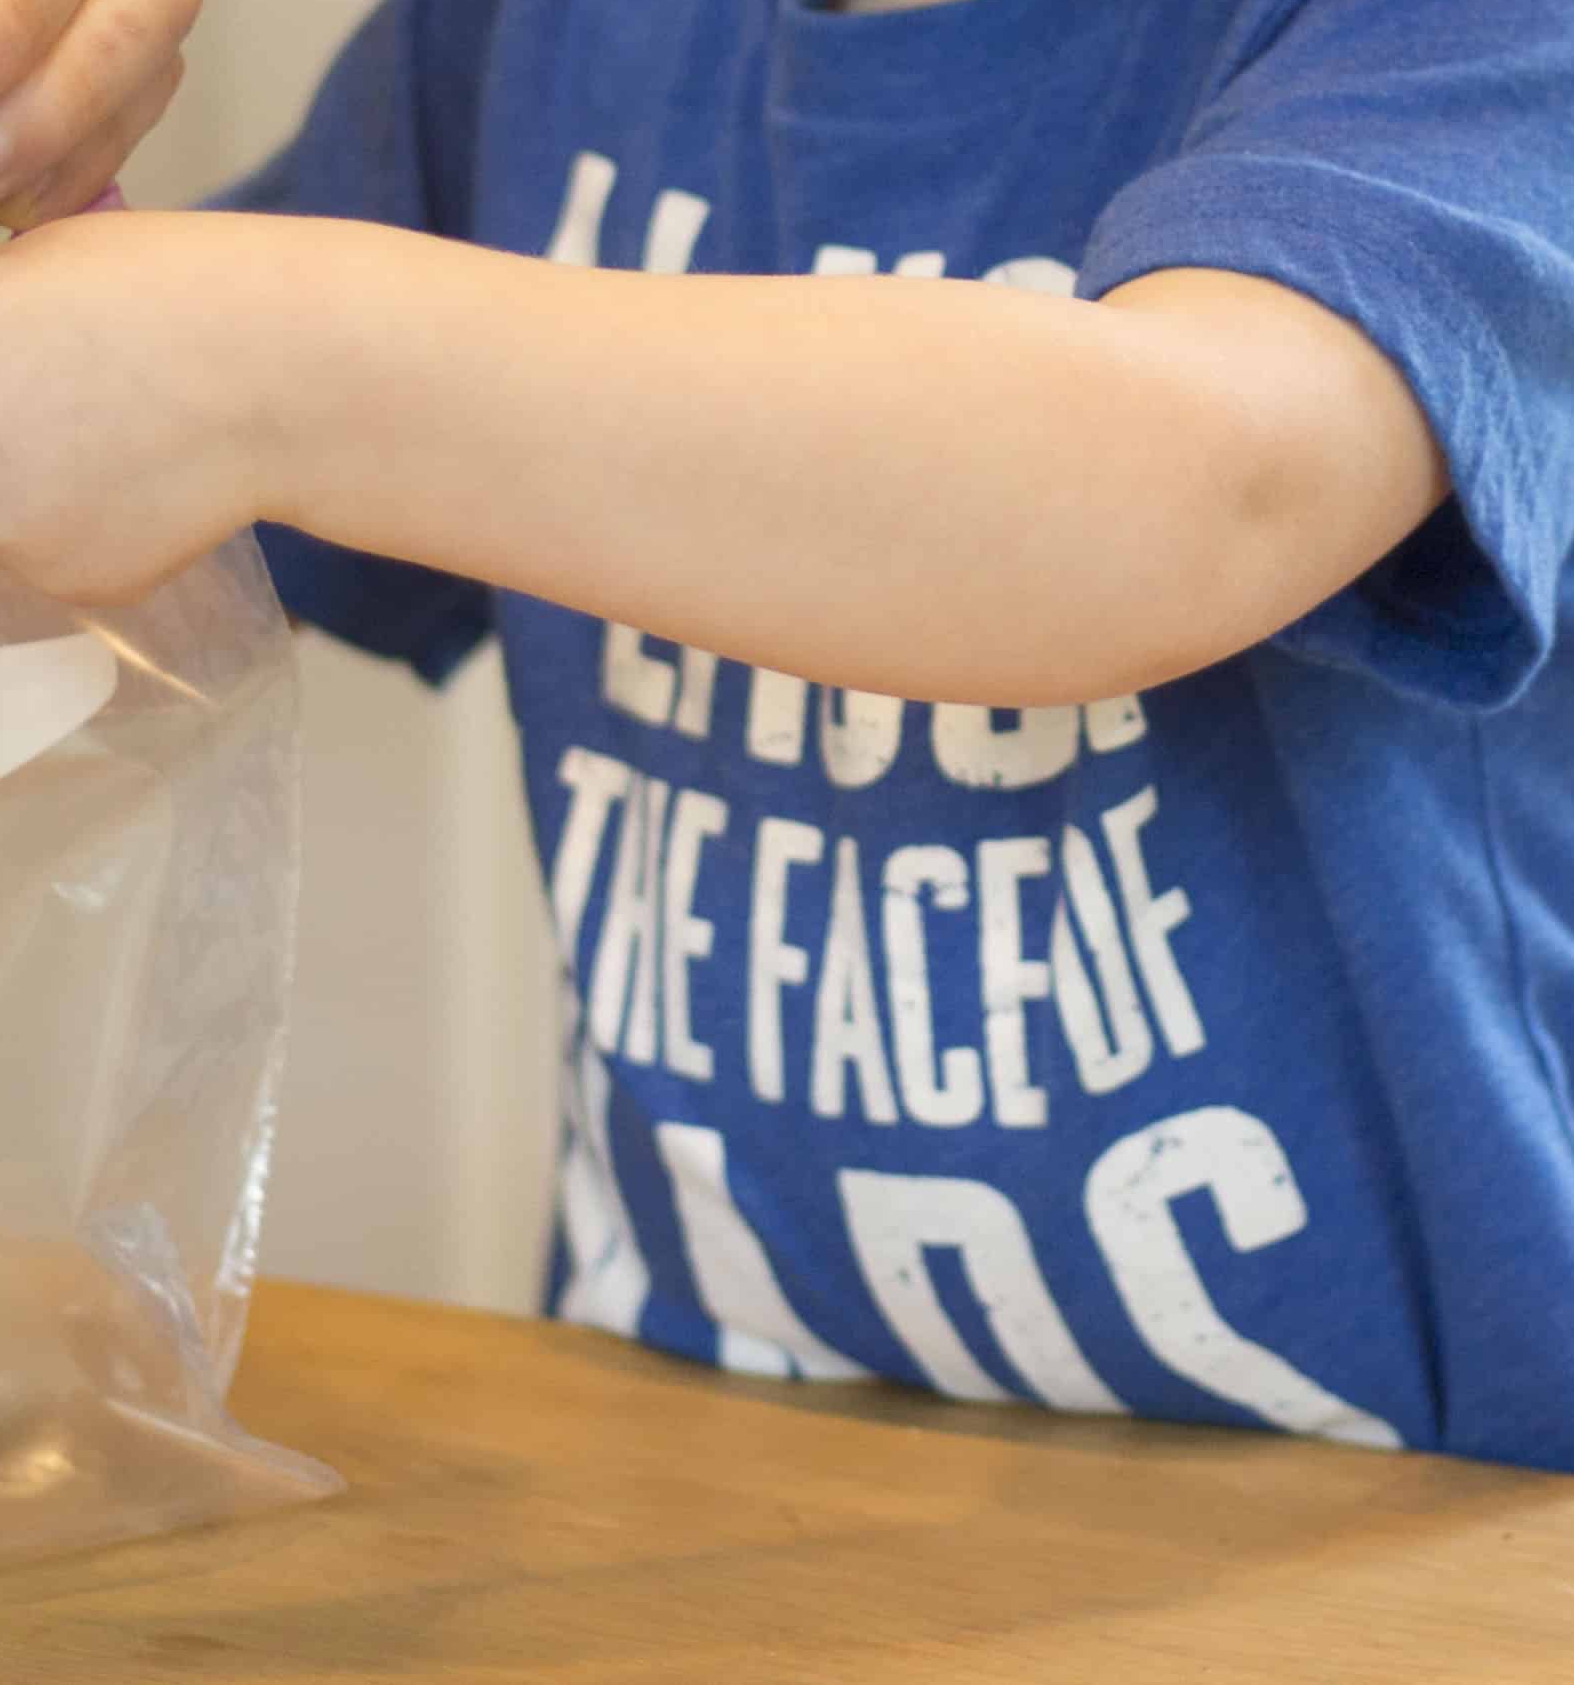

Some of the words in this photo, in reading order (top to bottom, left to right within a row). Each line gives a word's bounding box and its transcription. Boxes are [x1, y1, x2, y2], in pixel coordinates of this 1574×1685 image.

[550, 745, 729, 1083] THE
[746, 815, 1052, 1129] FACE
[1047, 784, 1207, 1096] OF
